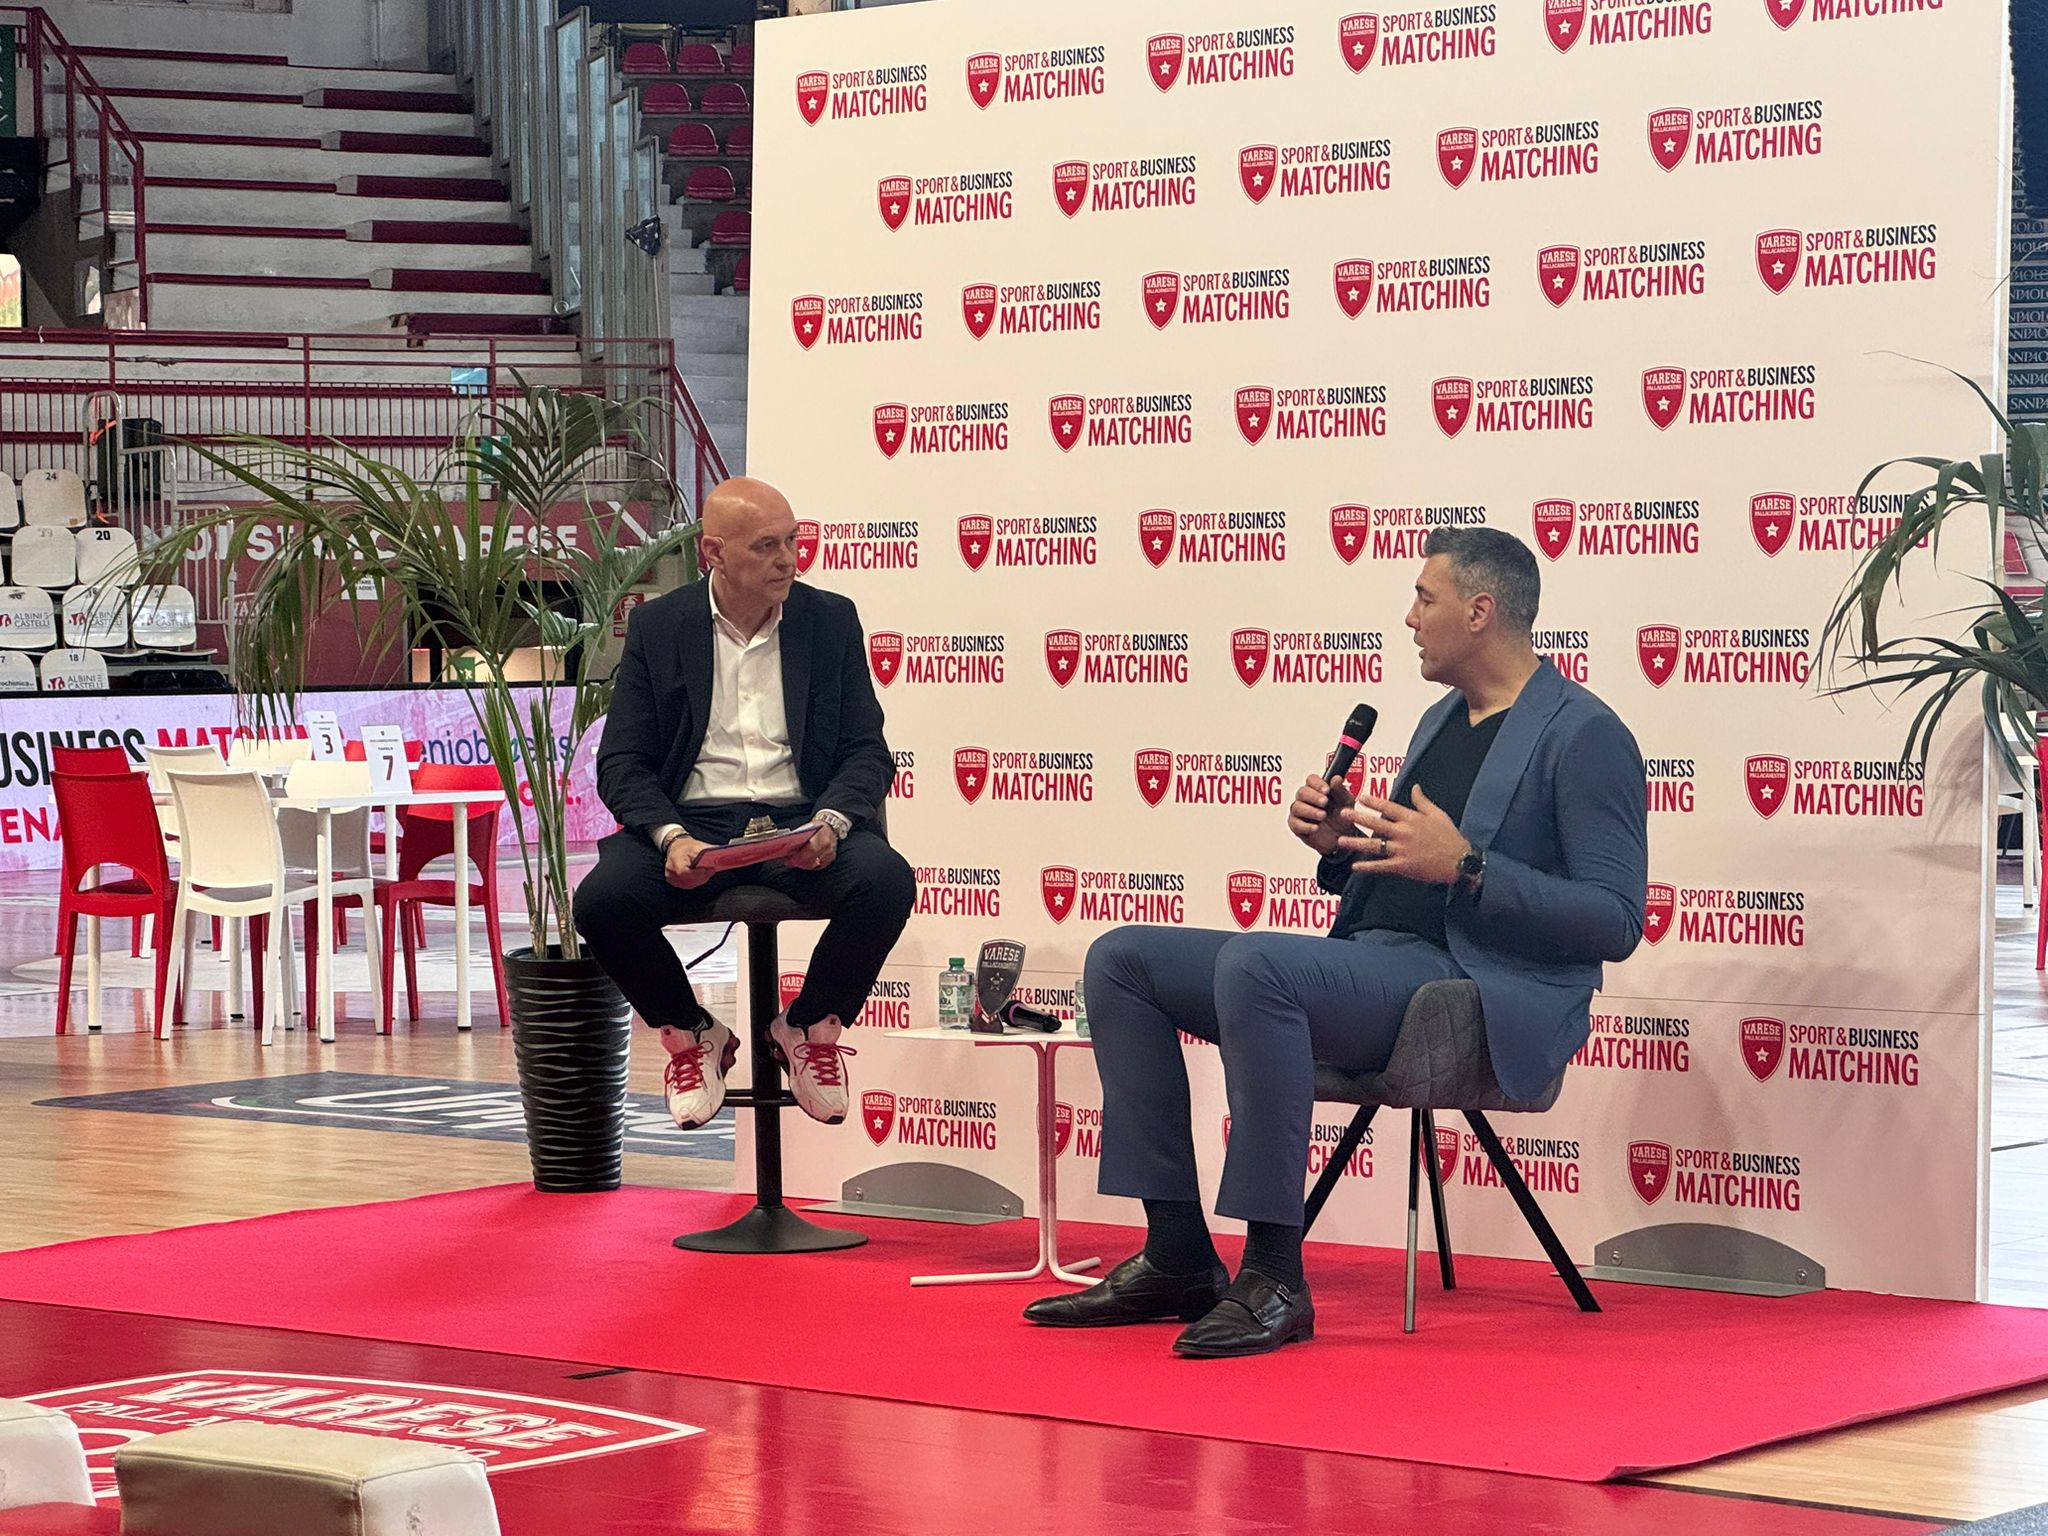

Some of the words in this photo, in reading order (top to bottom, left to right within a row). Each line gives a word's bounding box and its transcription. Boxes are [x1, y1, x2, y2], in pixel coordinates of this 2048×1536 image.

[1342, 16, 1375, 31] VARESE
[1382, 3, 1496, 33] SPORT&BUSINESS
[1590, 2, 1712, 45] MATCHING
[1150, 37, 1181, 52] VARESE
[1187, 25, 1294, 54] SPORT&BUSINESS
[1381, 25, 1496, 66] MATCHING
[969, 56, 998, 70] VARESE
[1004, 44, 1105, 72] SPORT&BUSINESS
[1187, 46, 1294, 86] MATCHING
[799, 74, 826, 88] VARESE
[832, 64, 927, 90] SPORT&BUSINESS
[1004, 65, 1104, 103] MATCHING
[832, 83, 926, 120] MATCHING
[1652, 112, 1688, 127] VARESE
[1696, 100, 1822, 130] SPORT&BUSINESS
[1440, 131, 1474, 146] VARESE
[1481, 120, 1599, 148] SPORT&BUSINESS
[1695, 123, 1822, 164] MATCHING
[1242, 148, 1274, 162] VARESE
[1280, 138, 1391, 165] SPORT&BUSINESS
[1481, 142, 1599, 182] MATCHING
[1056, 164, 1086, 178] VARESE
[1092, 154, 1196, 180] SPORT&BUSINESS
[881, 180, 909, 193] VARESE
[915, 170, 1013, 195] SPORT&BUSINESS
[1280, 160, 1391, 198] MATCHING
[1092, 175, 1196, 212] MATCHING
[915, 190, 1012, 226] MATCHING
[1760, 233, 1798, 248] VARESE
[1806, 224, 1936, 251] SPORT&BUSINESS
[1541, 249, 1576, 263] VARESE
[1583, 240, 1705, 266] SPORT&BUSINESS
[1337, 263, 1370, 277] VARESE
[1377, 255, 1491, 280] SPORT&BUSINESS
[1805, 247, 1936, 287] MATCHING
[1000, 280, 1100, 303] SPORT&BUSINESS
[1146, 276, 1177, 289] VARESE
[1183, 268, 1290, 292] SPORT&BUSINESS
[1583, 262, 1705, 301] MATCHING
[795, 299, 822, 311] VARESE
[828, 292, 922, 314] SPORT&BUSINESS
[965, 287, 994, 300] VARESE
[1376, 277, 1490, 314] MATCHING
[1000, 300, 1100, 334] MATCHING
[1183, 289, 1290, 324] MATCHING
[827, 312, 922, 345] MATCHING
[1435, 381, 1469, 394] VARESE
[1476, 375, 1594, 399] SPORT&BUSINESS
[1646, 371, 1682, 385] VARESE
[1689, 365, 1815, 389] SPORT&BUSINESS
[1052, 399, 1082, 411] VARESE
[1088, 394, 1192, 415] SPORT&BUSINESS
[1238, 390, 1270, 403] VARESE
[1276, 385, 1386, 408] SPORT&BUSINESS
[1689, 388, 1815, 424] MATCHING
[877, 407, 905, 419] VARESE
[911, 402, 1008, 423] SPORT&BUSINESS
[1276, 406, 1386, 440] MATCHING
[1475, 397, 1593, 432] MATCHING
[910, 422, 1008, 454] MATCHING
[1088, 414, 1191, 447] MATCHING
[46, 472, 56, 480] 24
[1536, 503, 1571, 516] VARESE
[1578, 500, 1700, 521] SPORT&BUSINESS
[1754, 497, 1791, 510] VARESE
[961, 519, 990, 530] VARESE
[996, 516, 1096, 535] SPORT&BUSINESS
[1142, 514, 1172, 526] VARESE
[1179, 510, 1286, 530] SPORT&BUSINESS
[1333, 509, 1366, 522] VARESE
[1373, 506, 1487, 526] SPORT&BUSINESS
[96, 530, 110, 540] 20
[823, 521, 917, 539] SPORT&BUSINESS
[1578, 522, 1700, 556] MATCHING
[823, 540, 917, 570] MATCHING
[996, 536, 1096, 566] MATCHING
[1178, 532, 1285, 563] MATCHING
[872, 636, 900, 646] VARESE
[906, 635, 1004, 652] SPORT&BUSINESS
[1049, 634, 1078, 646] VARESE
[1084, 634, 1188, 651] SPORT&BUSINESS
[1235, 633, 1266, 644] VARESE
[1273, 632, 1383, 650] SPORT&BUSINESS
[1641, 630, 1677, 642] VARESE
[1684, 629, 1810, 648] SPORT&BUSINESS
[70, 654, 78, 662] 18
[906, 655, 1003, 683] MATCHING
[1084, 654, 1188, 683] MATCHING
[1272, 653, 1383, 683] MATCHING
[1684, 652, 1810, 683] MATCHING
[322, 734, 334, 754] 3
[382, 755, 394, 780] 7
[958, 752, 987, 763] VARESE
[993, 752, 1093, 770] SPORT&BUSINESS
[1139, 753, 1169, 765] VARESE
[1176, 754, 1282, 772] SPORT&BUSINESS
[1749, 759, 1786, 772] VARESE
[1794, 760, 1924, 780] SPORT&BUSINESS
[992, 772, 1092, 802] MATCHING
[1175, 774, 1282, 805] MATCHING
[1793, 782, 1923, 817] MATCHING
[1044, 870, 1074, 882] VARESE
[1080, 871, 1184, 892] SPORT&BUSINESS
[1230, 876, 1262, 888] VARESE
[1080, 891, 1183, 924] MATCHING
[1679, 888, 1805, 911] SPORT&BUSINESS
[1679, 911, 1804, 947] MATCHING
[984, 946, 1020, 962] VARESE
[1744, 1022, 1781, 1036] VARESE
[1789, 1024, 1919, 1050] SPORT&BUSINESS
[1788, 1047, 1918, 1086] MATCHING
[865, 1092, 893, 1105] VARESE
[899, 1095, 996, 1118] SPORT&BUSINESS
[899, 1114, 996, 1149] MATCHING
[1631, 1145, 1667, 1160] VARESE
[1675, 1148, 1800, 1176] SPORT&BUSINESS
[1674, 1170, 1800, 1211] MATCHING
[116, 1380, 619, 1450] VARESE
